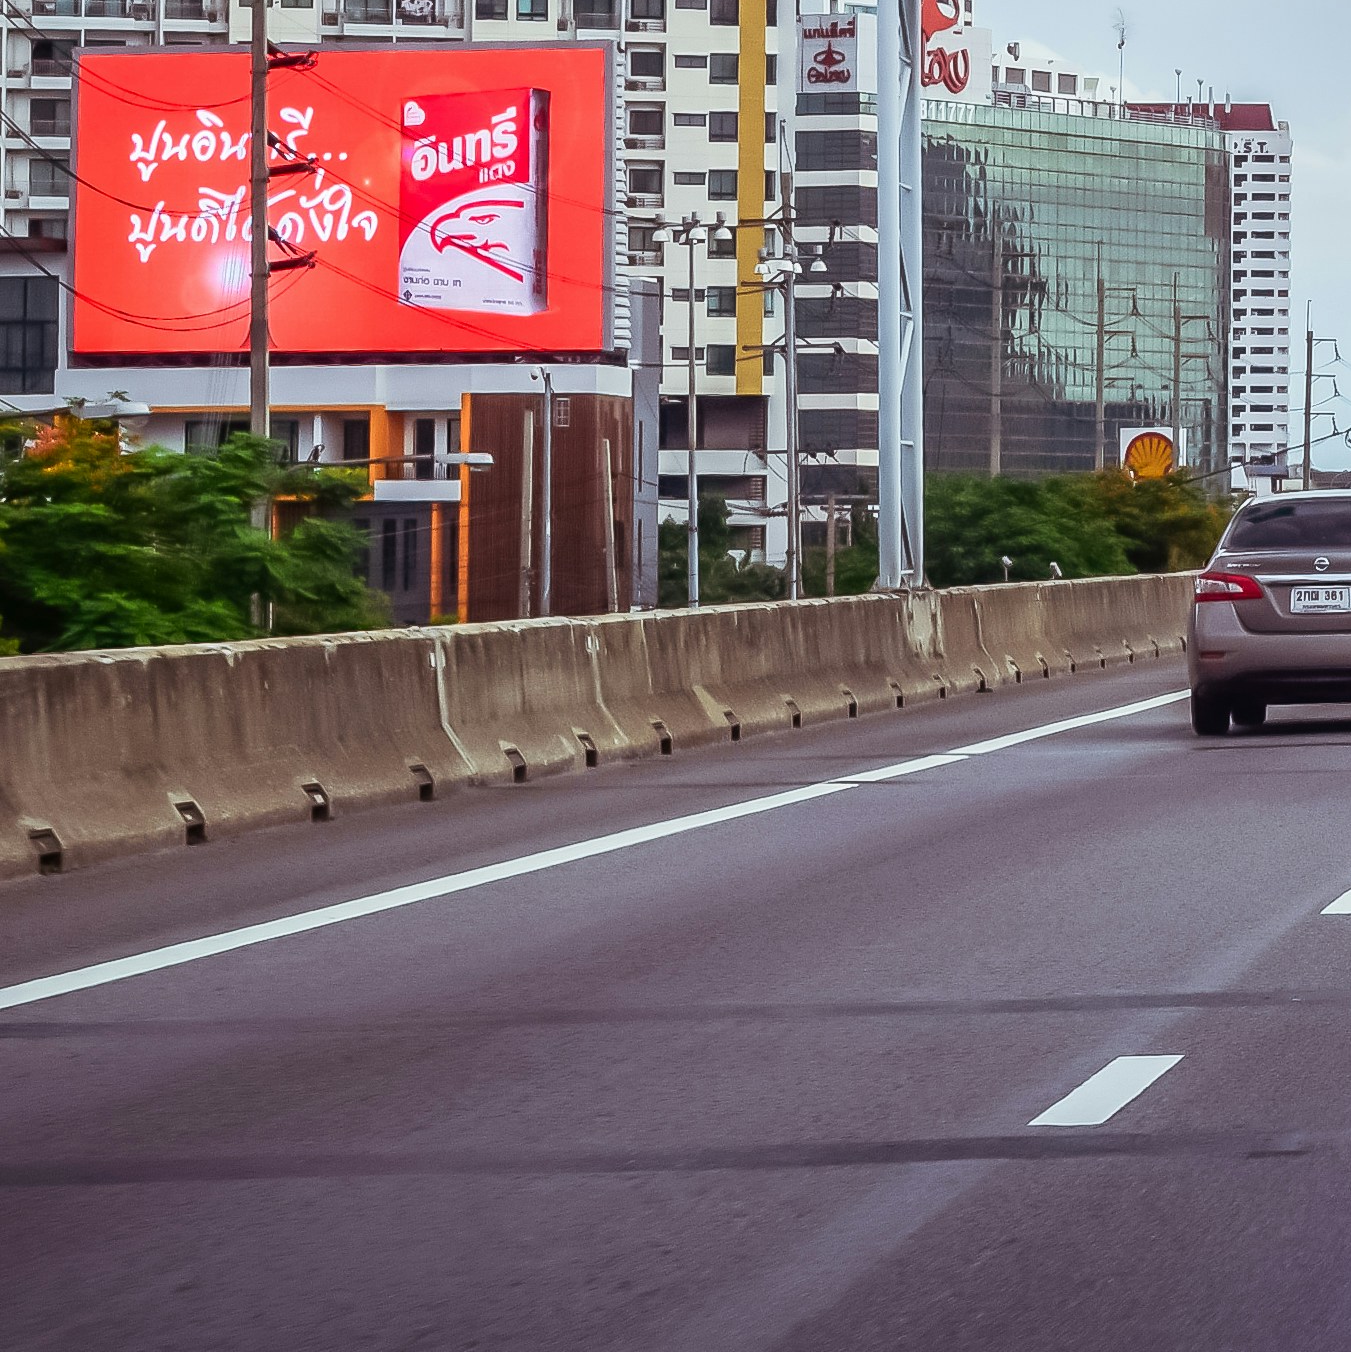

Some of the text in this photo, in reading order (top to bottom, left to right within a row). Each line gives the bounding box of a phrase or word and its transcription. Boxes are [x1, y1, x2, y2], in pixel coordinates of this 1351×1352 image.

[410, 105, 519, 182] อินทรี
[478, 160, 516, 184] แดง
